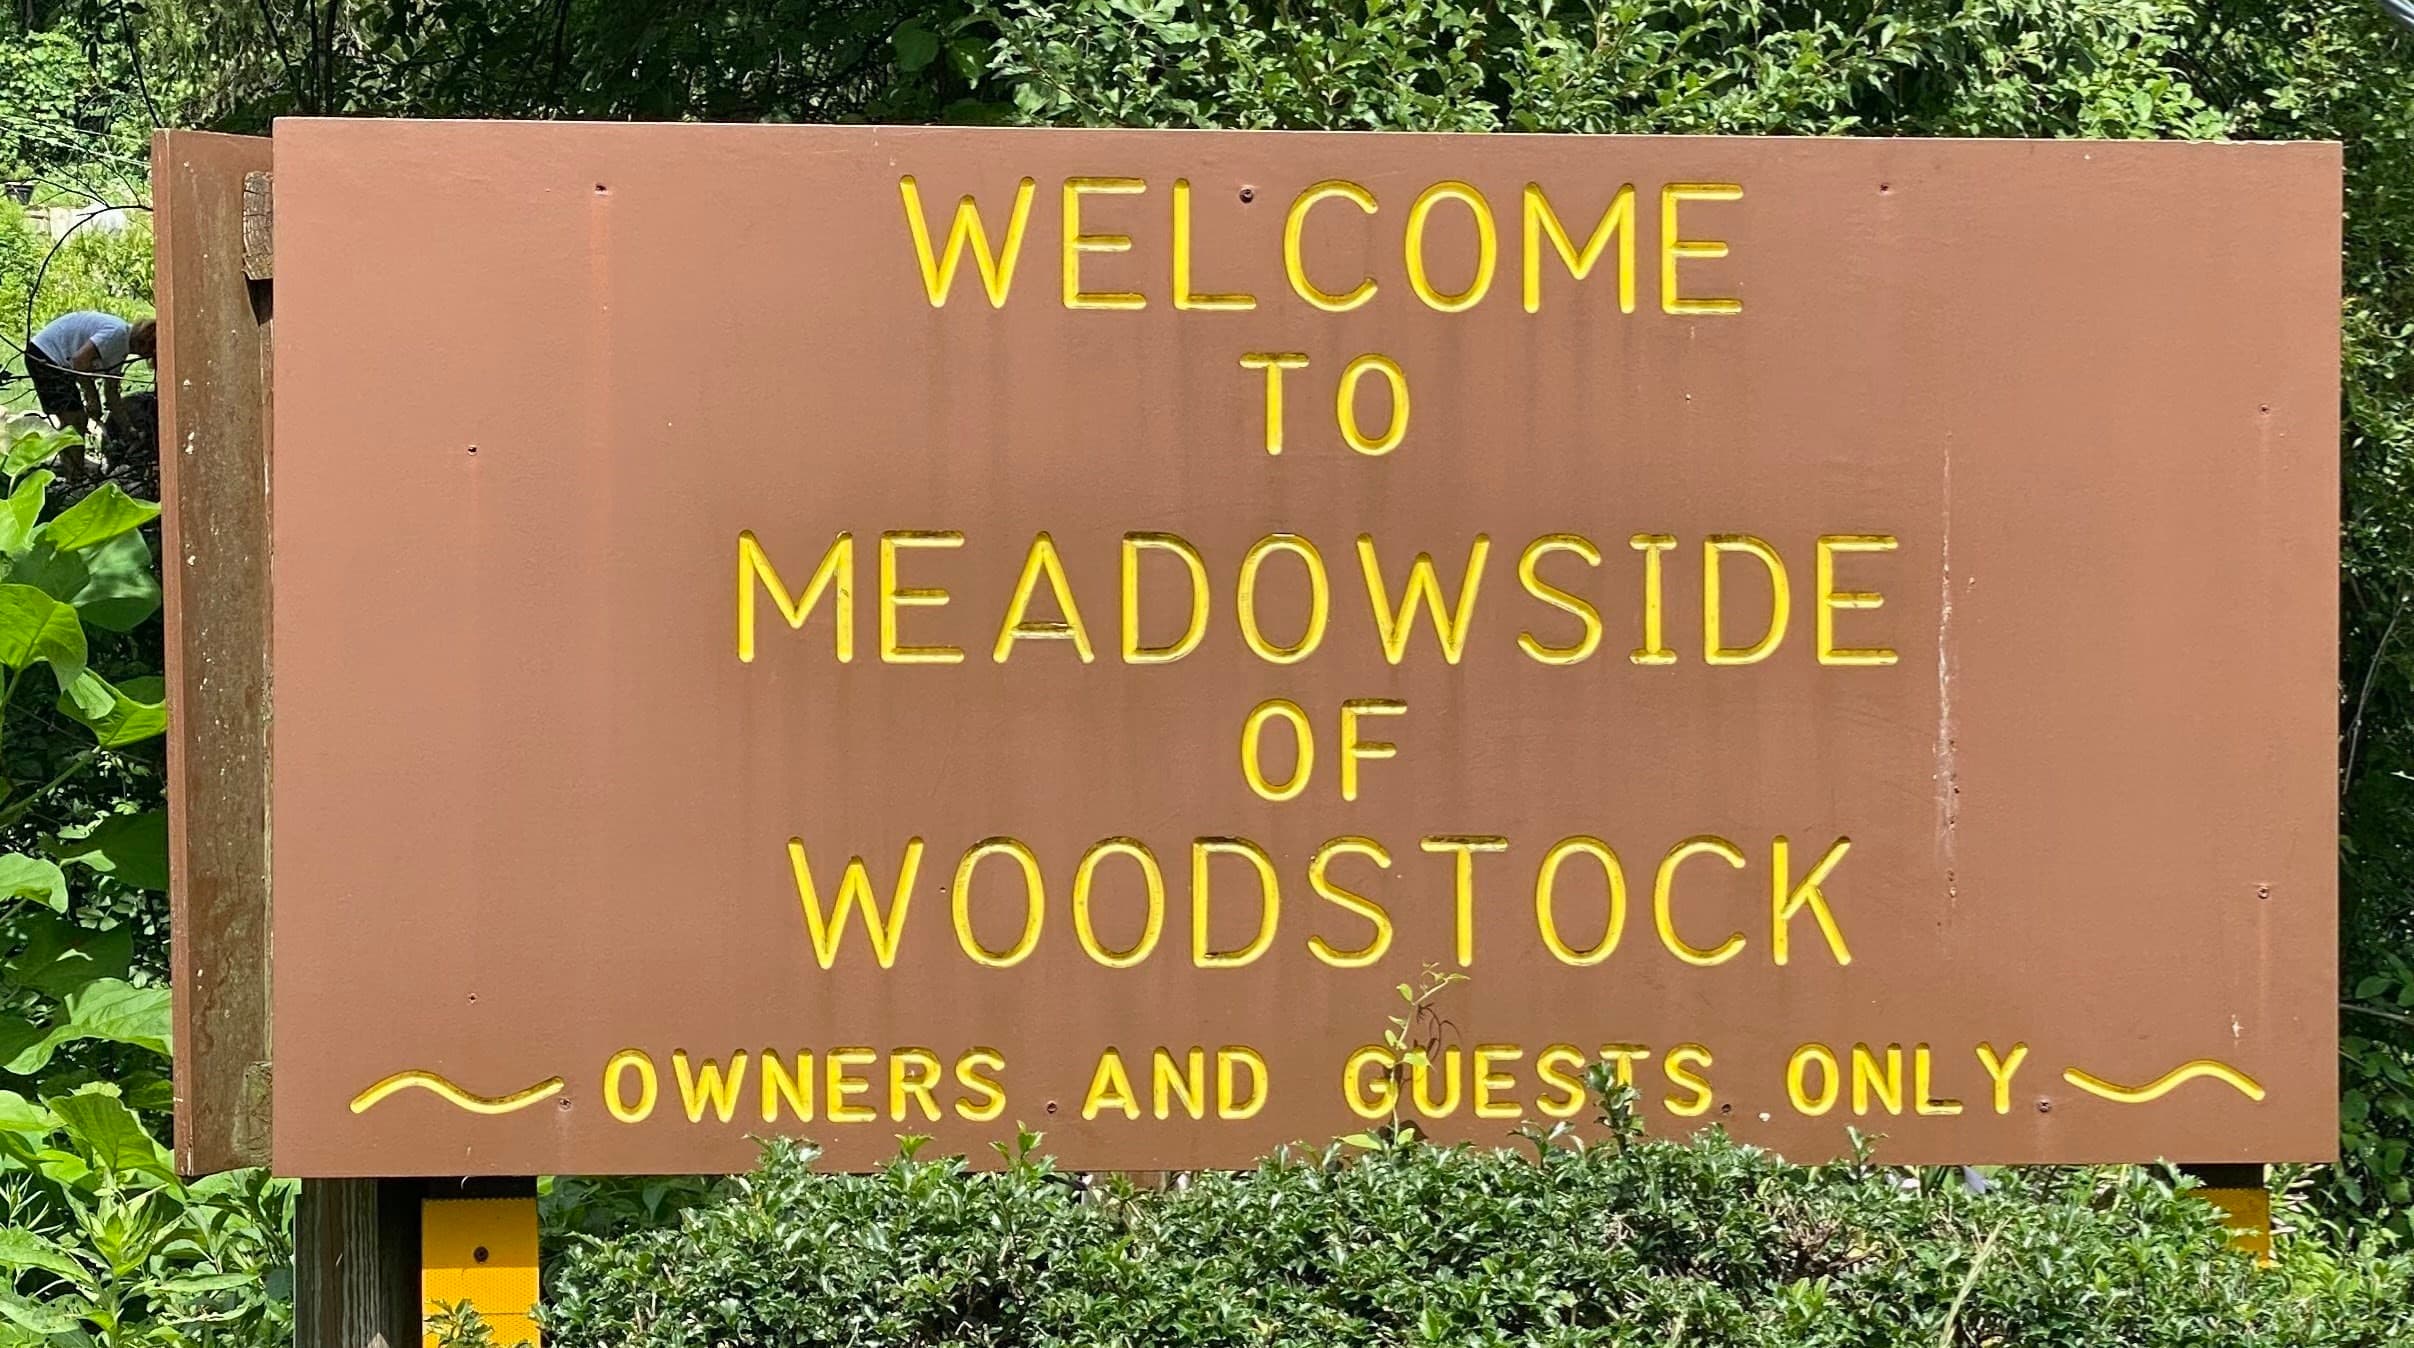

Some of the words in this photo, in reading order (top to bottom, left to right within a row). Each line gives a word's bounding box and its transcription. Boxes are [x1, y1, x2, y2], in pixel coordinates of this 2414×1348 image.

[898, 176, 1743, 314] WELCOME
[1240, 352, 1411, 457] TO
[736, 530, 1899, 666] MEADOWSIDE
[1240, 697, 1408, 801] OF
[787, 834, 1853, 969] WOODSTOCK
[602, 1047, 1009, 1124] OWNERS
[1080, 1046, 1270, 1121] AND
[1342, 1042, 1714, 1120] GUESTS
[1784, 1043, 2028, 1117] ONLY
